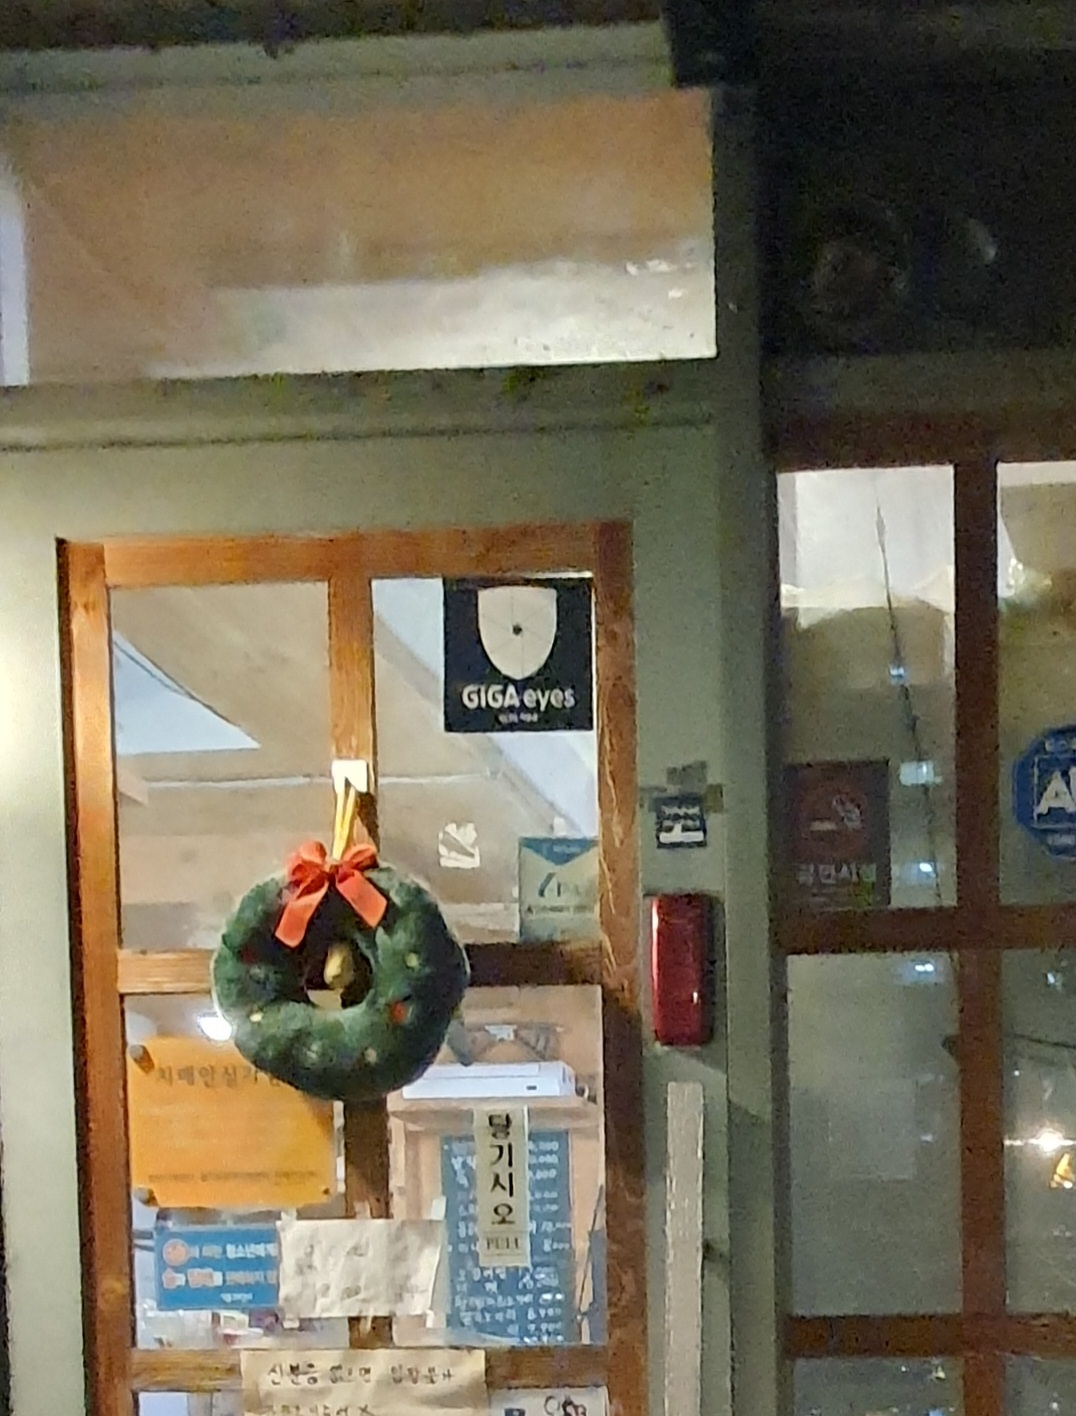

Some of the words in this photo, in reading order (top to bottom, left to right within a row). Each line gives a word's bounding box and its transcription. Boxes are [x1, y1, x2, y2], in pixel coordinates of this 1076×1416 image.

[462, 683, 520, 709] GIGA
[523, 688, 576, 711] eyes
[487, 1113, 516, 1224] 당기시오
